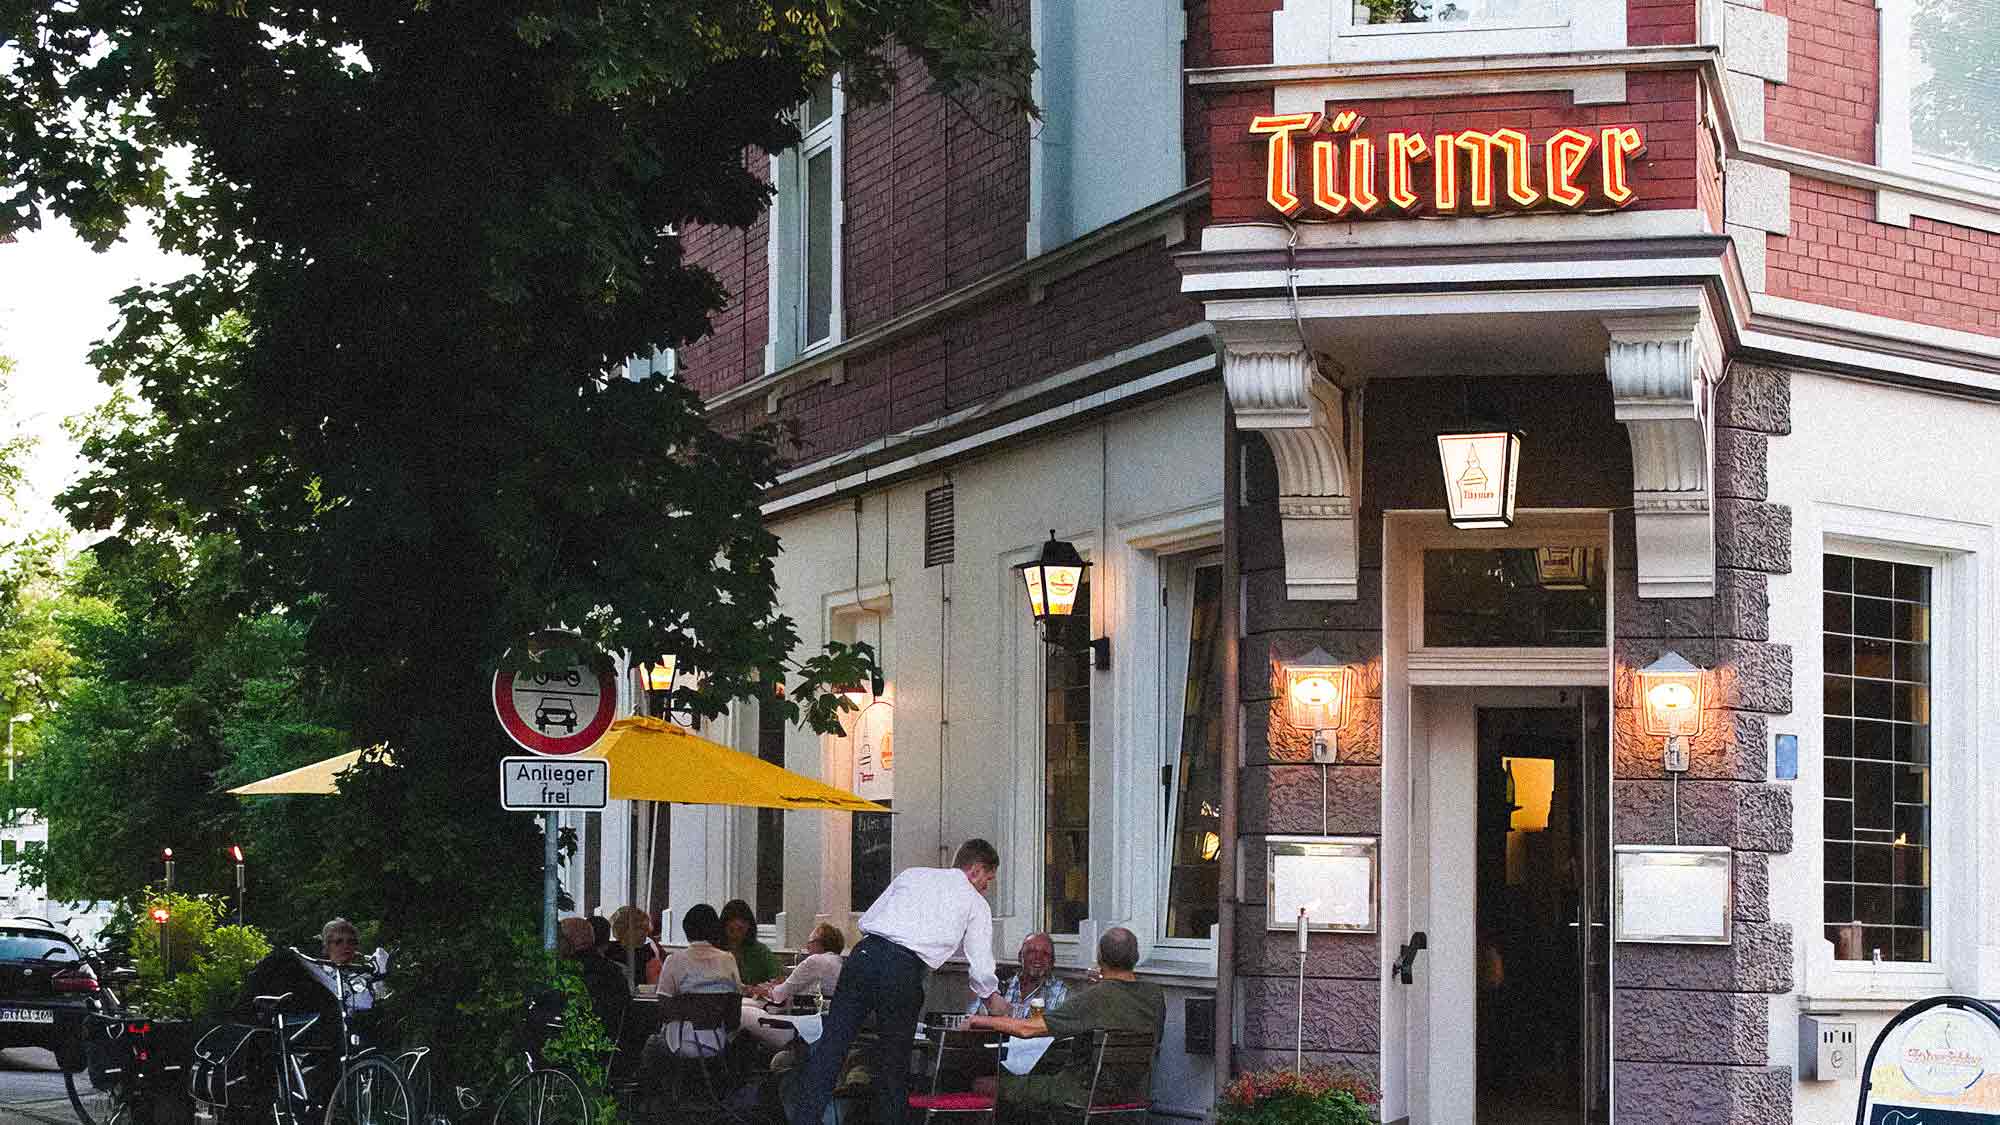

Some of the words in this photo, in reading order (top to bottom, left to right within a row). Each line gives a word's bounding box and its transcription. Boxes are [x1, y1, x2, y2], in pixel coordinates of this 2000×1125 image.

[1249, 111, 1644, 214] Türmer
[516, 764, 595, 785] Anlieger
[541, 784, 570, 804] frei
